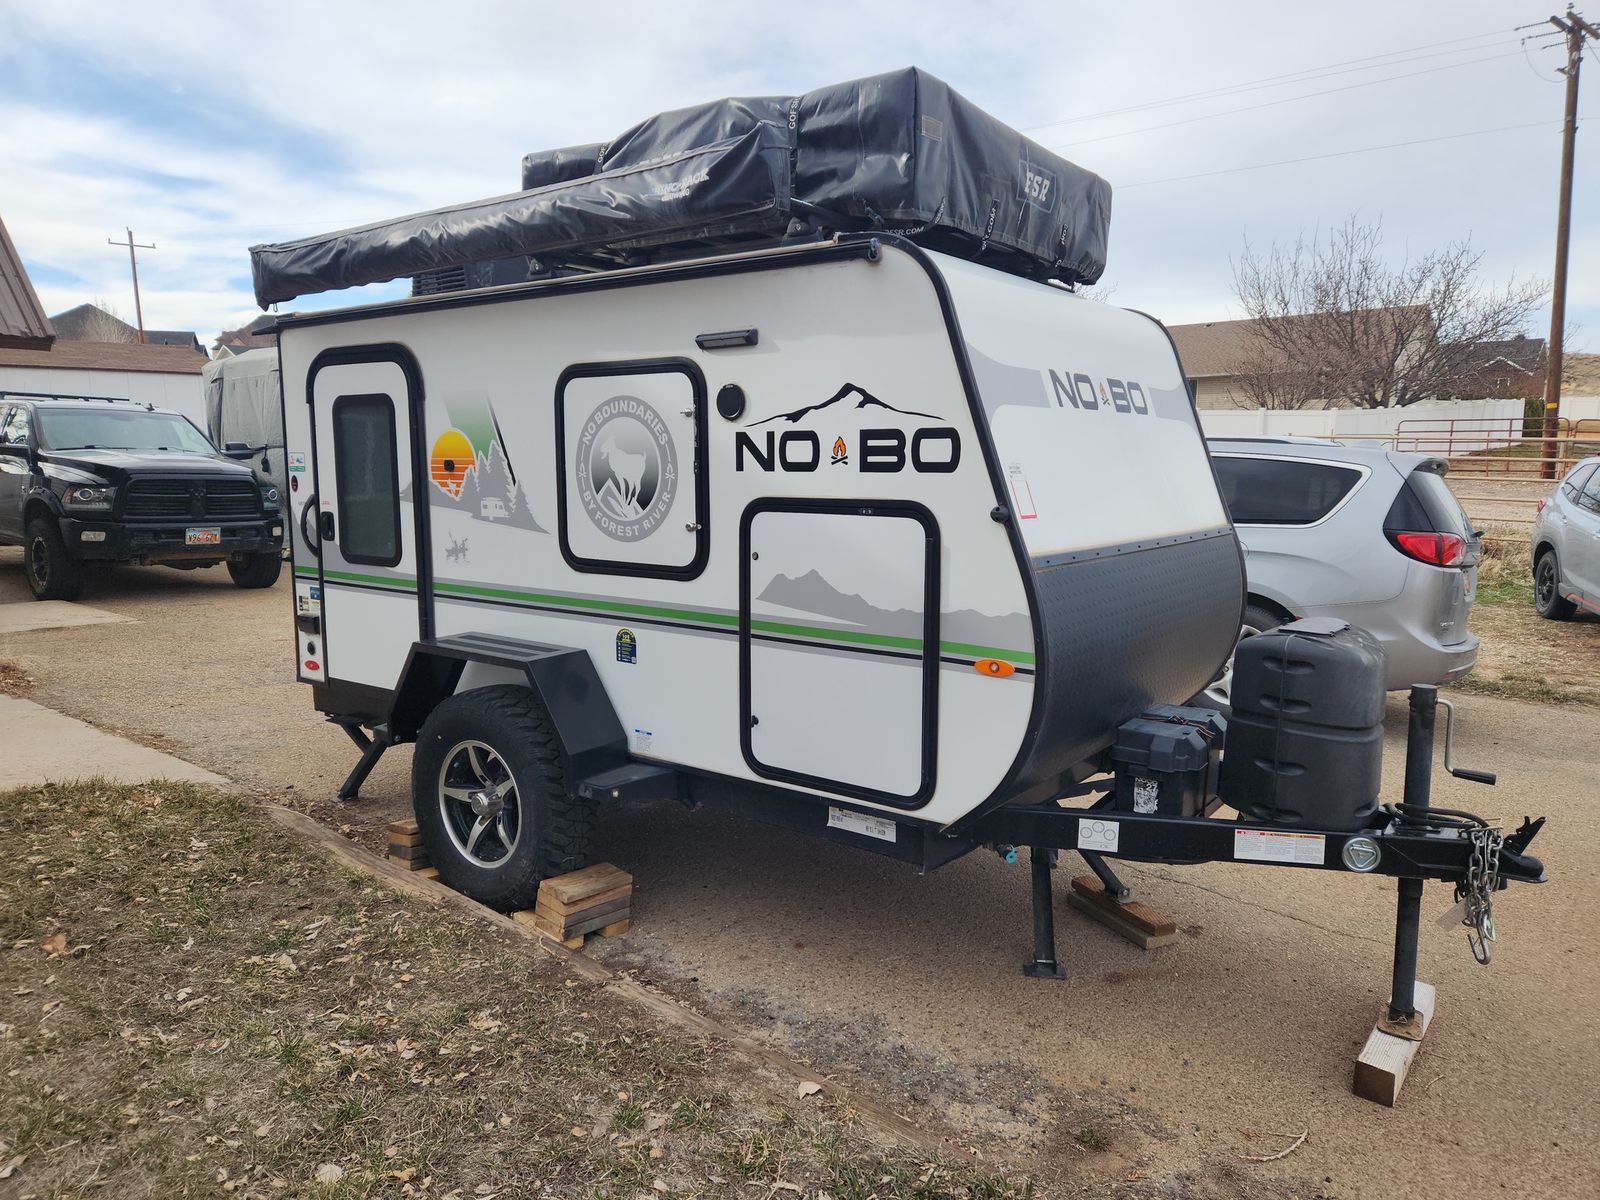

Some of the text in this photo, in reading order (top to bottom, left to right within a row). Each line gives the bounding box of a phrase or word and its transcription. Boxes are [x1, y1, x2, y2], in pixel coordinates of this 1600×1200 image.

[1024, 171, 1050, 202] FSR
[1048, 368, 1149, 415] NO BO
[582, 400, 669, 446] NO BOUNDARIES
[735, 427, 962, 474] NO BO
[583, 490, 671, 537] BY FOREST RIVER
